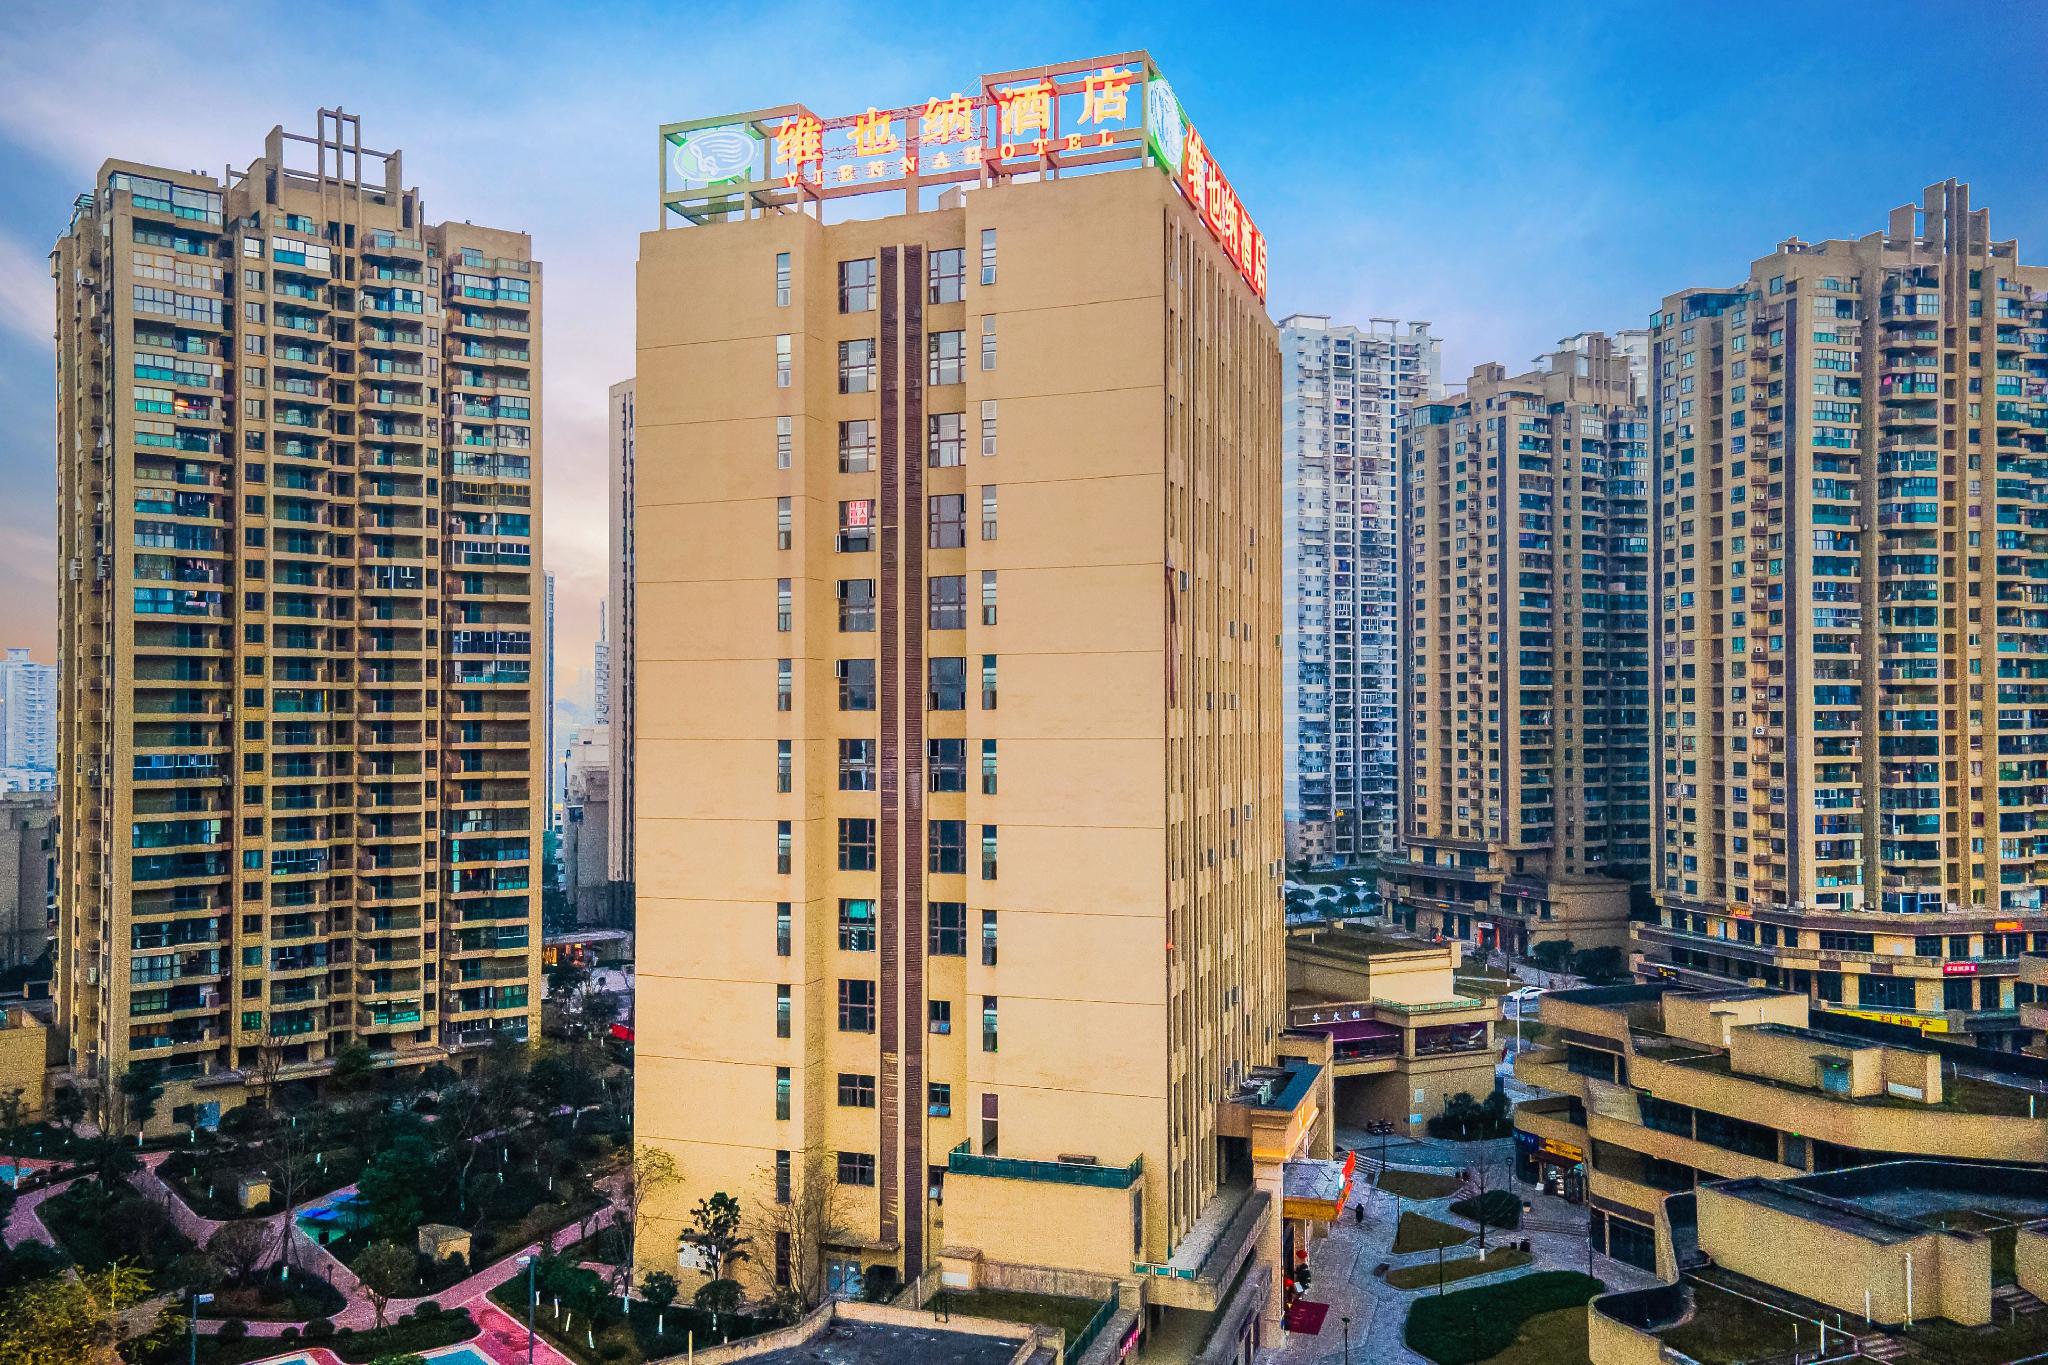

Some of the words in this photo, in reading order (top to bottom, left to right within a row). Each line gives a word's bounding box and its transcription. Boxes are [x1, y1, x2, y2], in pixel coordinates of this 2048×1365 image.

[775, 67, 1134, 165] 维也纳酒店
[1186, 130, 1266, 293] 维也纳酒店
